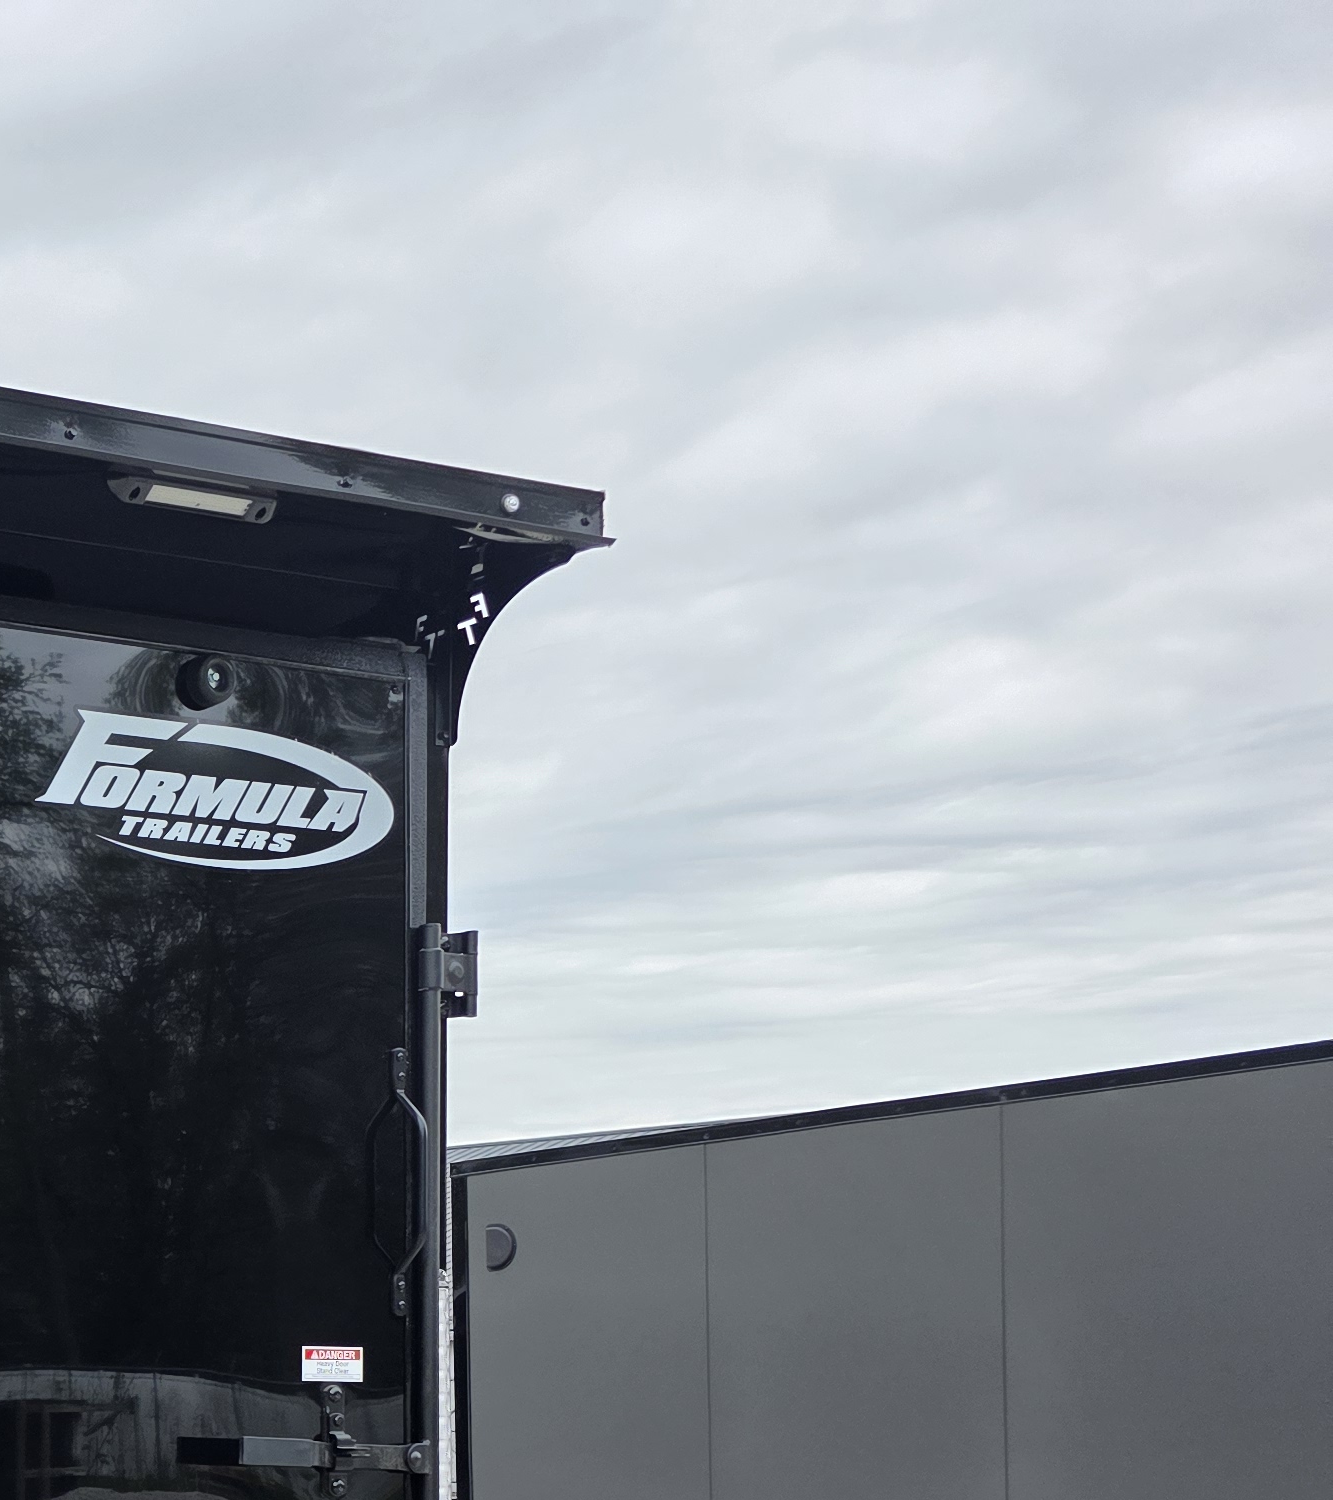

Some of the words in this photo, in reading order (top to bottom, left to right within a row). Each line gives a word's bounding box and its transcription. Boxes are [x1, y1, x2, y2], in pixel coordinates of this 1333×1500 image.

[34, 709, 365, 832] FORMULA
[118, 815, 297, 853] TRAILERS
[318, 1351, 355, 1360] DANGER
